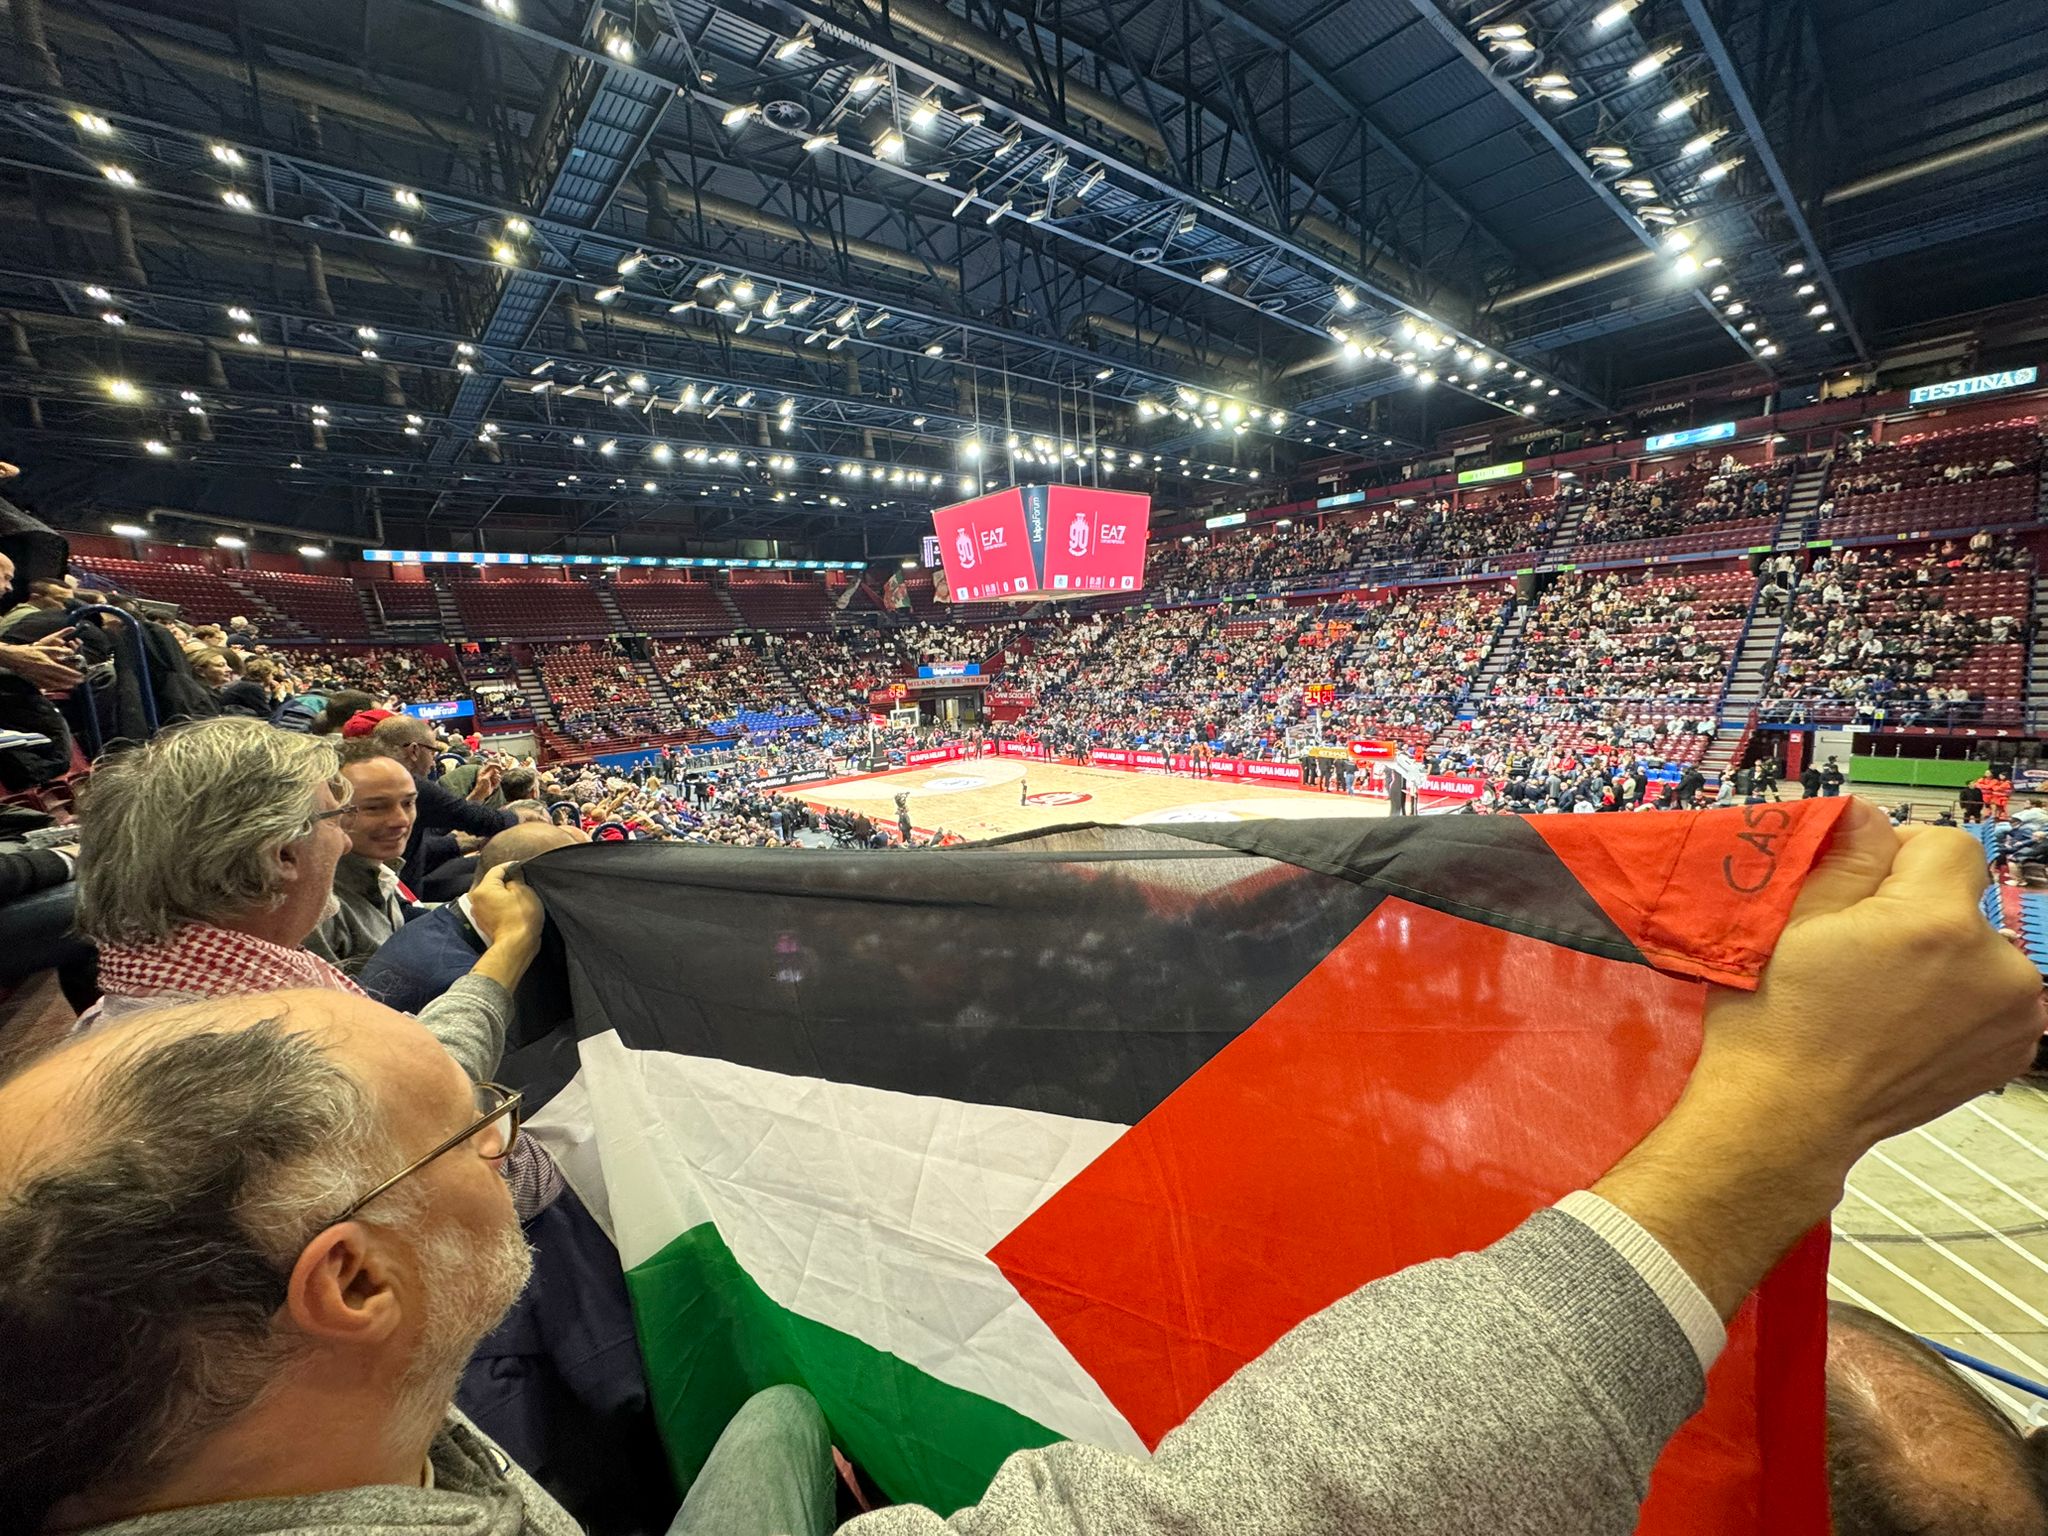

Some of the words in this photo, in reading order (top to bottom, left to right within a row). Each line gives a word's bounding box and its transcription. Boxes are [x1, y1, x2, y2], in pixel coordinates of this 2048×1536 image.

[1913, 370, 2013, 402] FESTINA
[1031, 496, 1044, 543] UnipolForum
[980, 527, 1004, 547] EA7
[1100, 524, 1126, 540] EA7
[907, 680, 937, 688] MILANO
[1304, 691, 1321, 704] 24
[1321, 690, 1333, 703] 24
[1248, 765, 1274, 774] OLIMPIA
[1274, 768, 1300, 778] MILANO
[1440, 781, 1475, 794] MILANO
